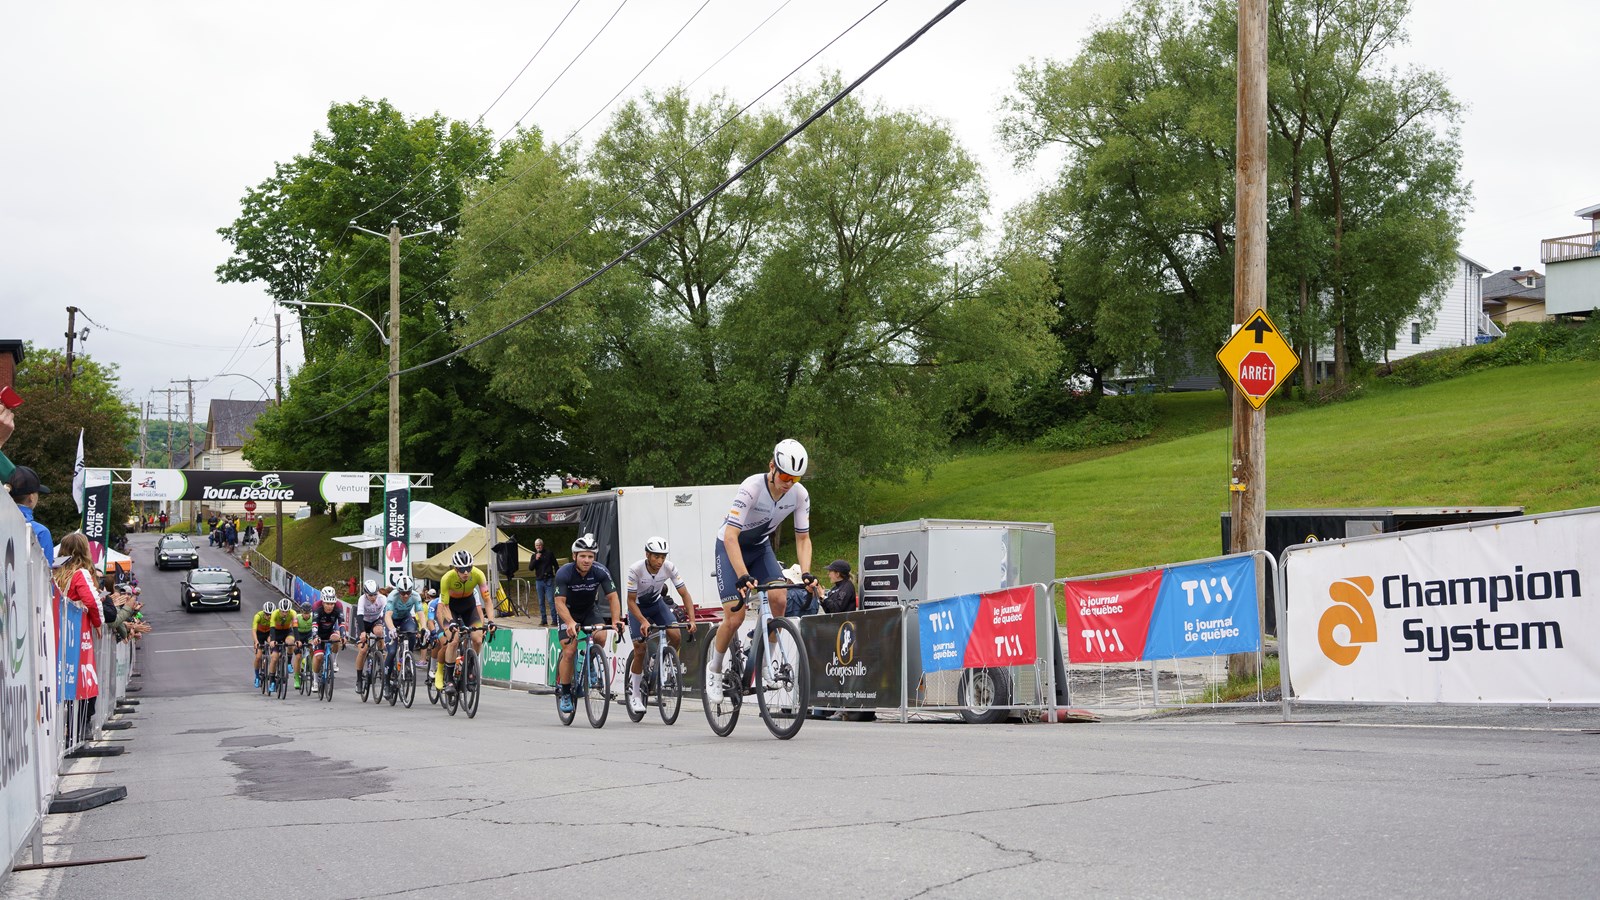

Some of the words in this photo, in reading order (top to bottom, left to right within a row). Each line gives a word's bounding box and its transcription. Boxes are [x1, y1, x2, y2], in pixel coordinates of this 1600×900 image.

[1241, 363, 1274, 381] ARRÊT
[203, 486, 236, 499] Tour
[239, 486, 294, 500] Beauce
[336, 484, 368, 492] Venture
[86, 494, 97, 538] AMERICA
[94, 512, 104, 538] TOUR
[389, 497, 398, 538] AMERICA
[397, 513, 405, 538] TOUR
[716, 555, 725, 591] TORONTO
[1181, 576, 1233, 606] TVA
[1382, 565, 1581, 612] Champion
[993, 607, 1000, 616] le
[1001, 604, 1022, 616] journal
[1080, 607, 1091, 616] de
[1092, 605, 1124, 616] québec
[1088, 594, 1119, 607] journal
[993, 616, 1001, 624] de
[1184, 621, 1194, 631] le
[1196, 616, 1233, 632] journal
[995, 634, 1023, 657] TVA
[1081, 628, 1124, 653] TVA
[1185, 632, 1198, 642] de
[1201, 628, 1239, 642] québec
[1402, 618, 1564, 661] System
[489, 646, 510, 666] Desjardins
[520, 647, 545, 668] Desjardins
[832, 652, 839, 665] le
[825, 661, 867, 685] Georgesville
